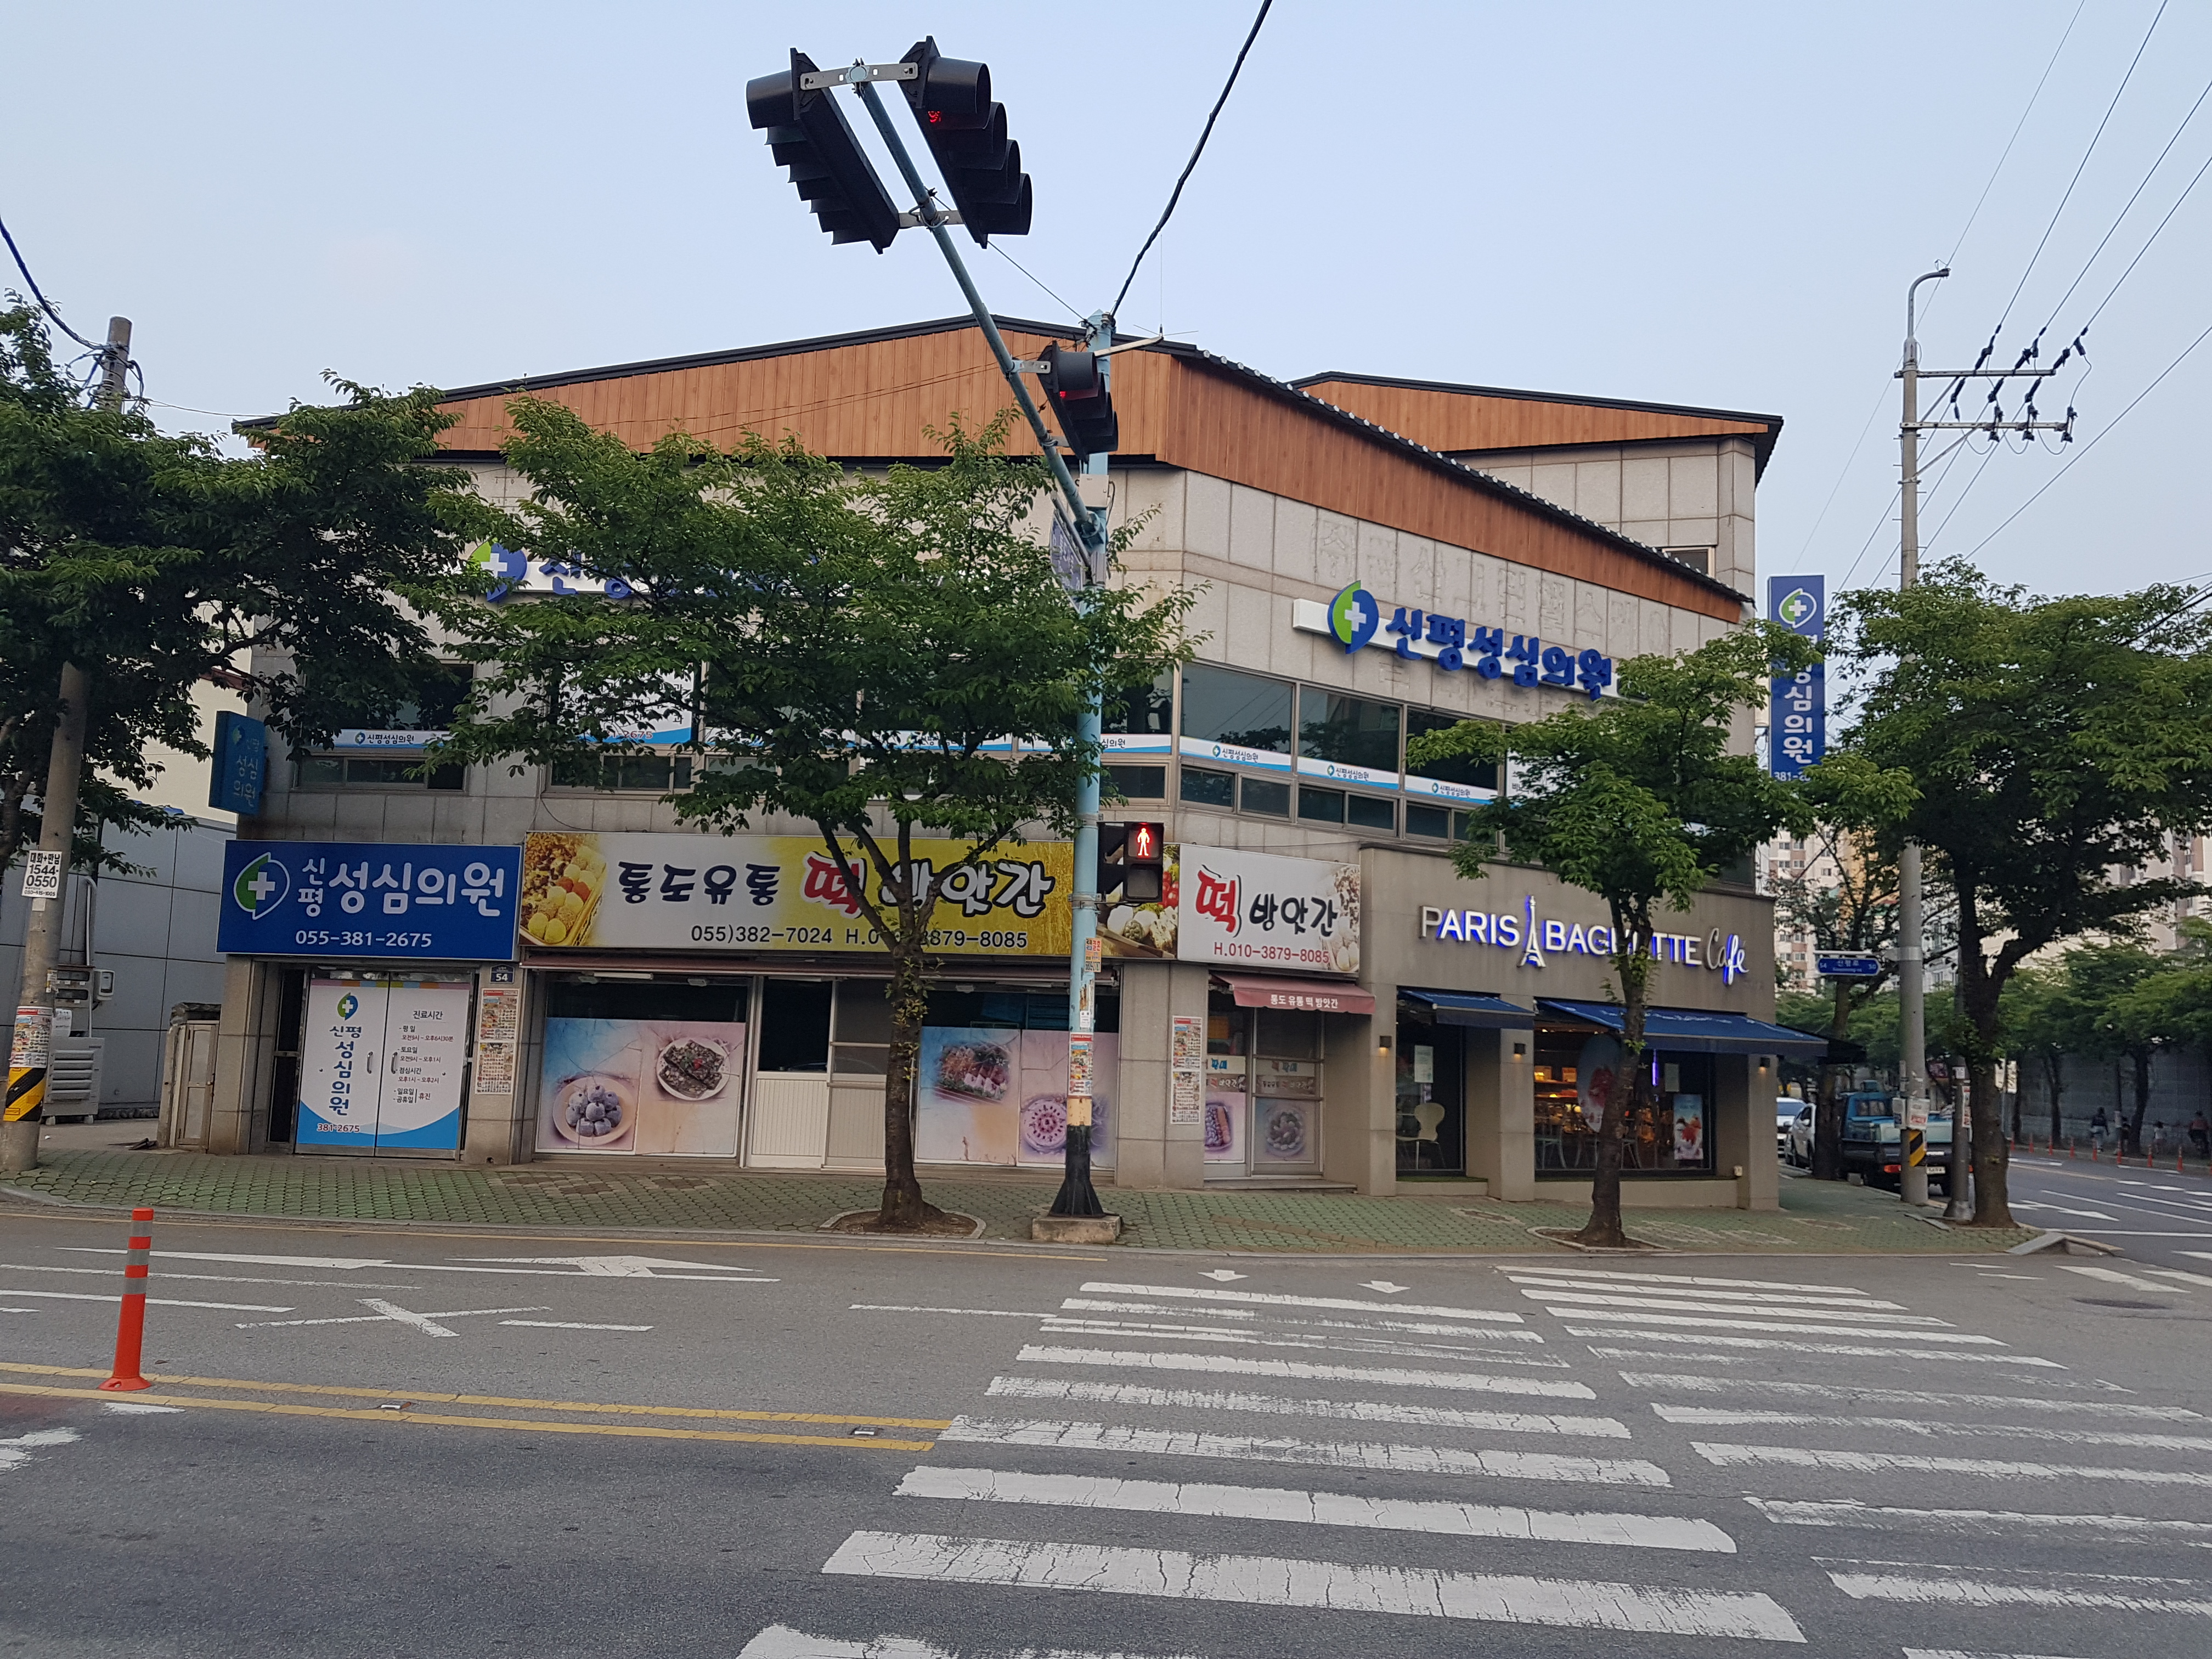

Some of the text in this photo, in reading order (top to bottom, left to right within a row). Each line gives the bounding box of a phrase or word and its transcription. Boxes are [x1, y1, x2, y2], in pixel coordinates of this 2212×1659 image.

[1385, 608, 1612, 701] 신평성심의원
[367, 733, 415, 745] 신평성심의원
[1221, 747, 1259, 764] 신평성심의원
[1335, 766, 1369, 782] 신평성심의원
[1439, 784, 1470, 798] 신평성심의원
[26, 874, 57, 888] 0550
[329, 861, 504, 917] 성심의원
[618, 861, 781, 906] 통도유통
[1195, 865, 1339, 937] 떡 방앗간
[691, 925, 832, 944] 055)382-7024
[1420, 906, 1521, 946] PARIS
[295, 930, 432, 947] 055-381-2675
[1214, 942, 1330, 964] H.010-3879-8085
[495, 973, 508, 981] 54
[1315, 998, 1338, 1010] 방앗간
[413, 1011, 443, 1020] 진료시간
[329, 1025, 362, 1039] 신평
[329, 1040, 354, 1116] 성심의원
[317, 1123, 360, 1133] 381-2675
